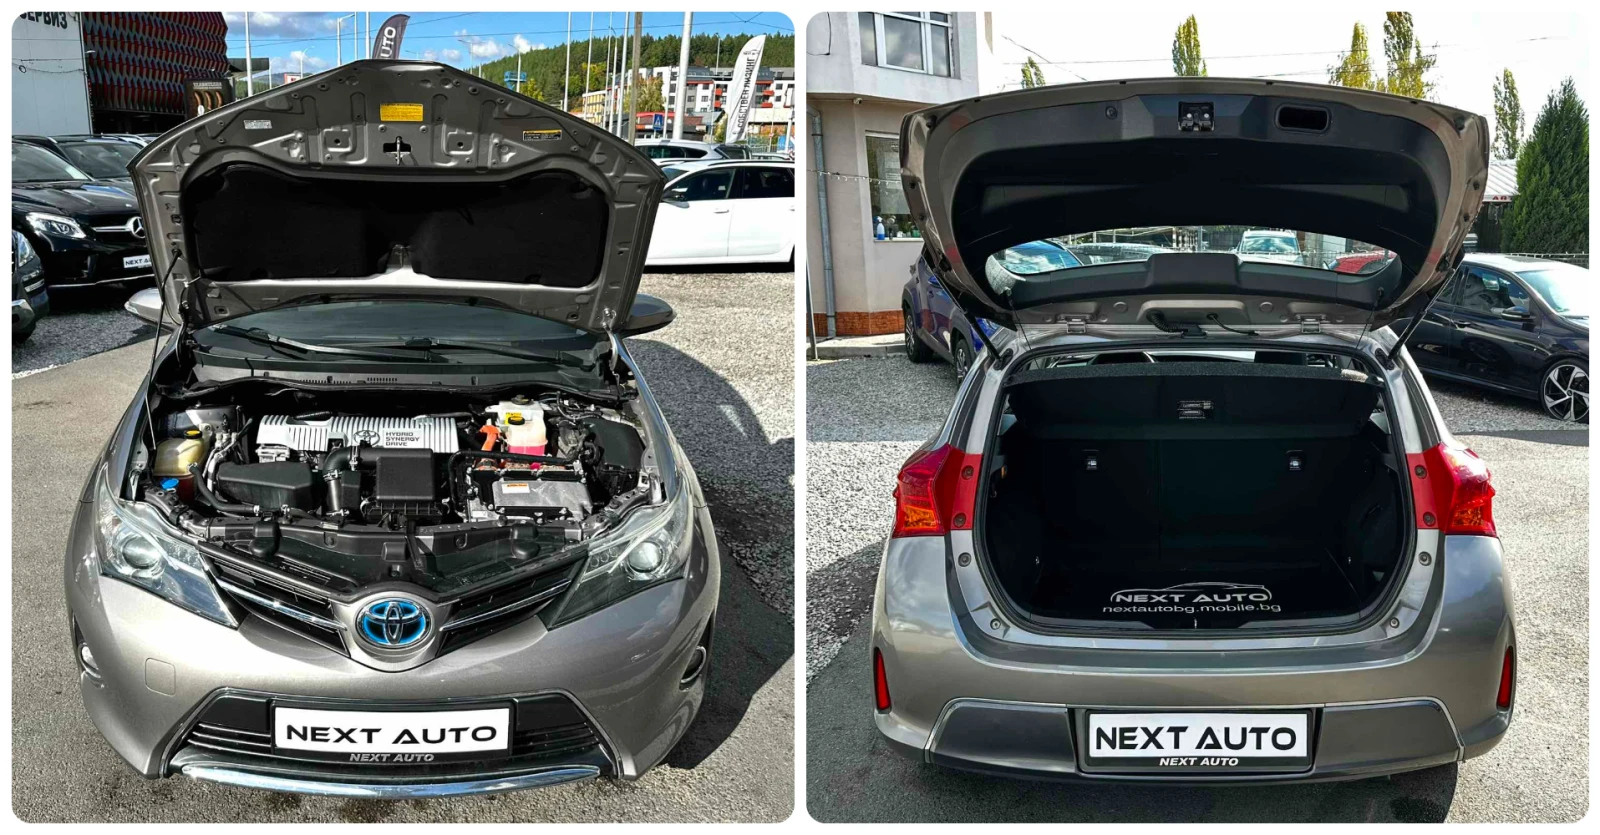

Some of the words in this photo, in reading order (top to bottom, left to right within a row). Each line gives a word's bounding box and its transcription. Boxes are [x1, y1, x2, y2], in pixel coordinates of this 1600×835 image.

[380, 26, 397, 59] UTO
[1115, 592, 1185, 602] NEXT
[1192, 592, 1269, 602] AUTO
[1102, 603, 1282, 614] nextautobg.mobile.bg
[286, 724, 382, 744] NEXT
[391, 726, 497, 745] AUTO
[1096, 726, 1189, 750] NEXT
[1195, 726, 1297, 751] AUTO
[349, 753, 390, 763] NEXT
[392, 753, 435, 763] AUTO
[1159, 757, 1199, 766] NEXT
[1199, 757, 1239, 766] AUTO
